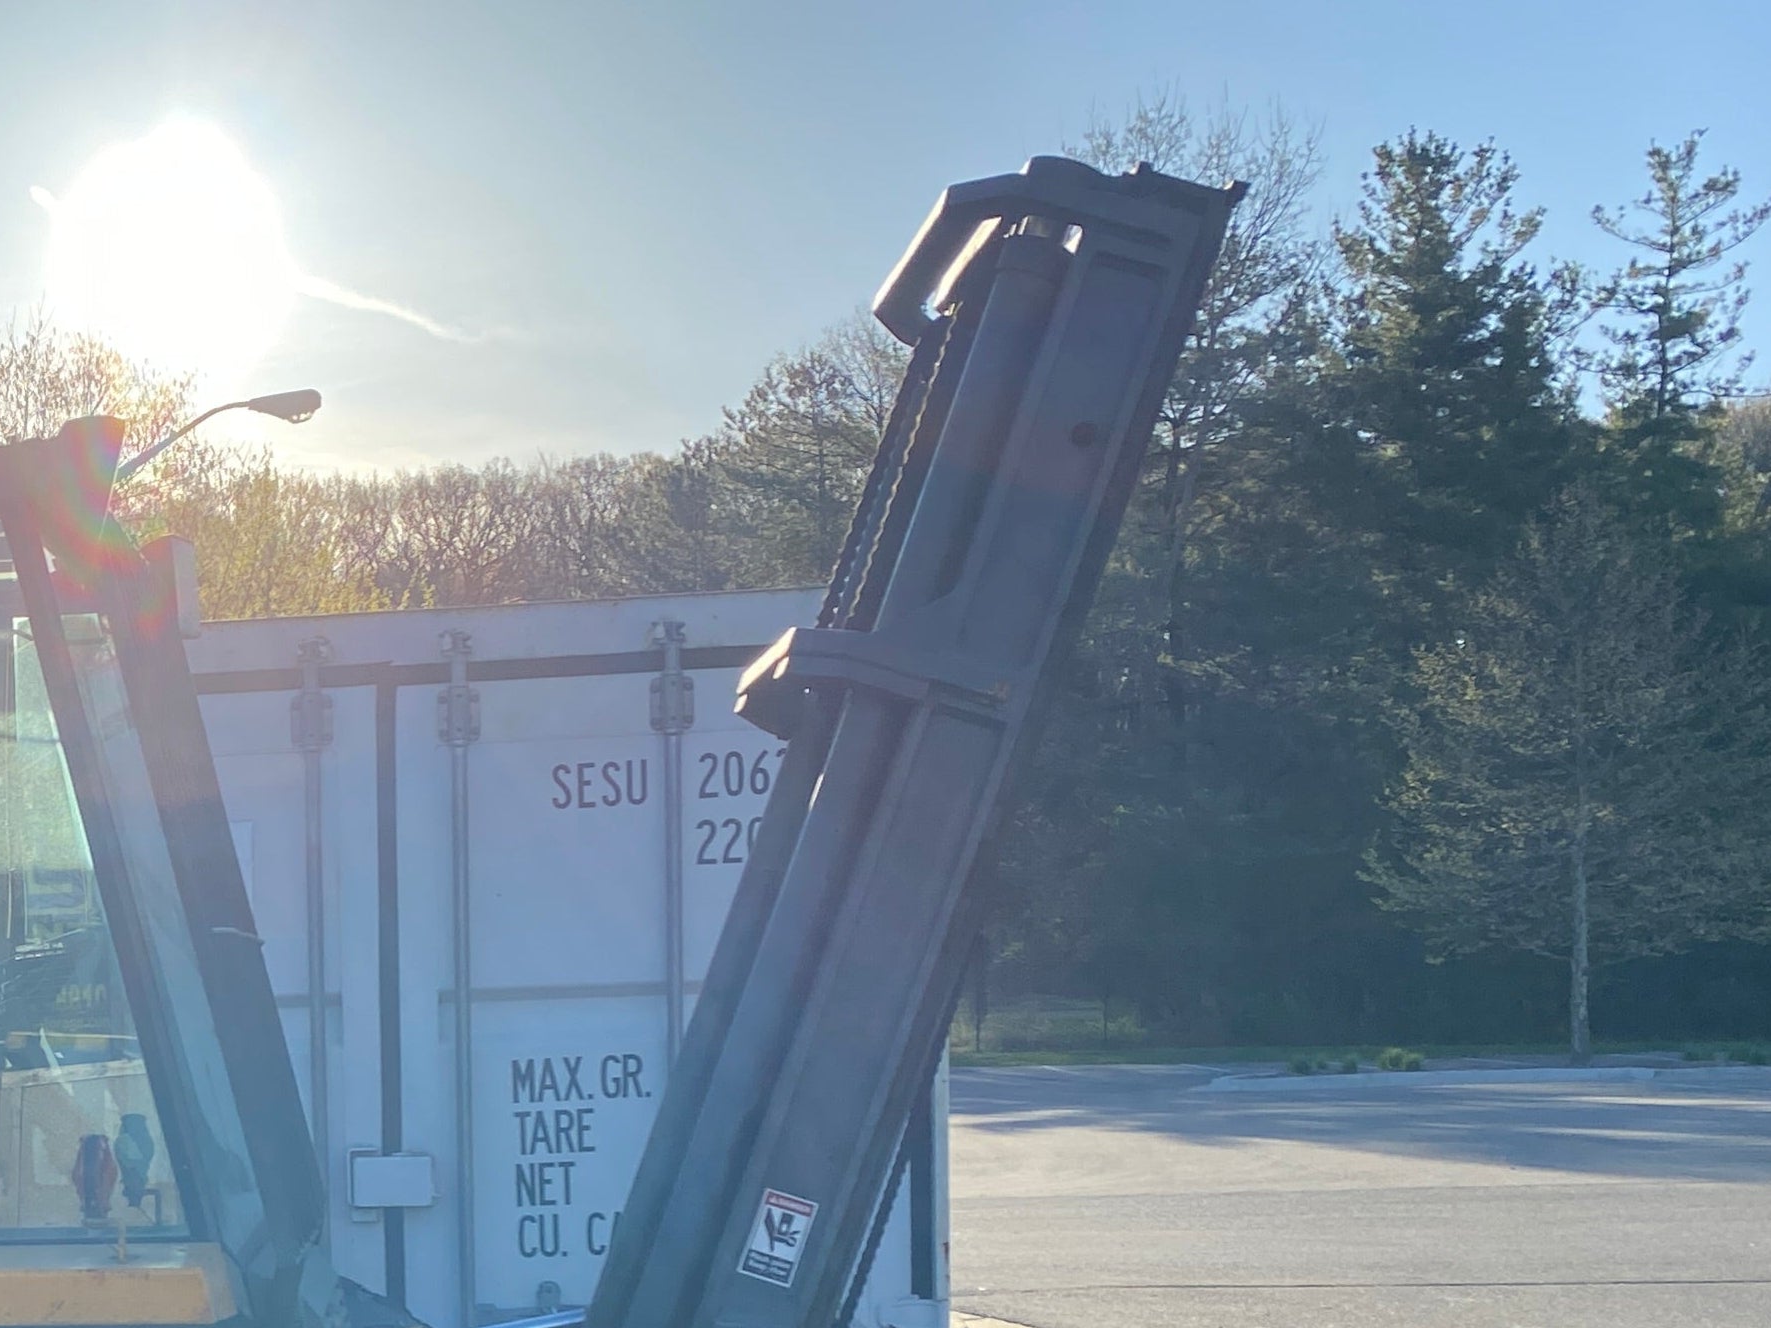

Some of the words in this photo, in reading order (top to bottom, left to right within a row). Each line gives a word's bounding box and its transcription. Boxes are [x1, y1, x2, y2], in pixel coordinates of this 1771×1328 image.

[551, 759, 648, 809] SESU
[698, 748, 786, 799] 206
[511, 1056, 594, 1104] MAX.
[600, 1053, 652, 1099] GR.
[513, 1107, 596, 1155] TARE
[515, 1161, 576, 1207] NET
[518, 1213, 568, 1258] CU.
[586, 1211, 624, 1256] C
